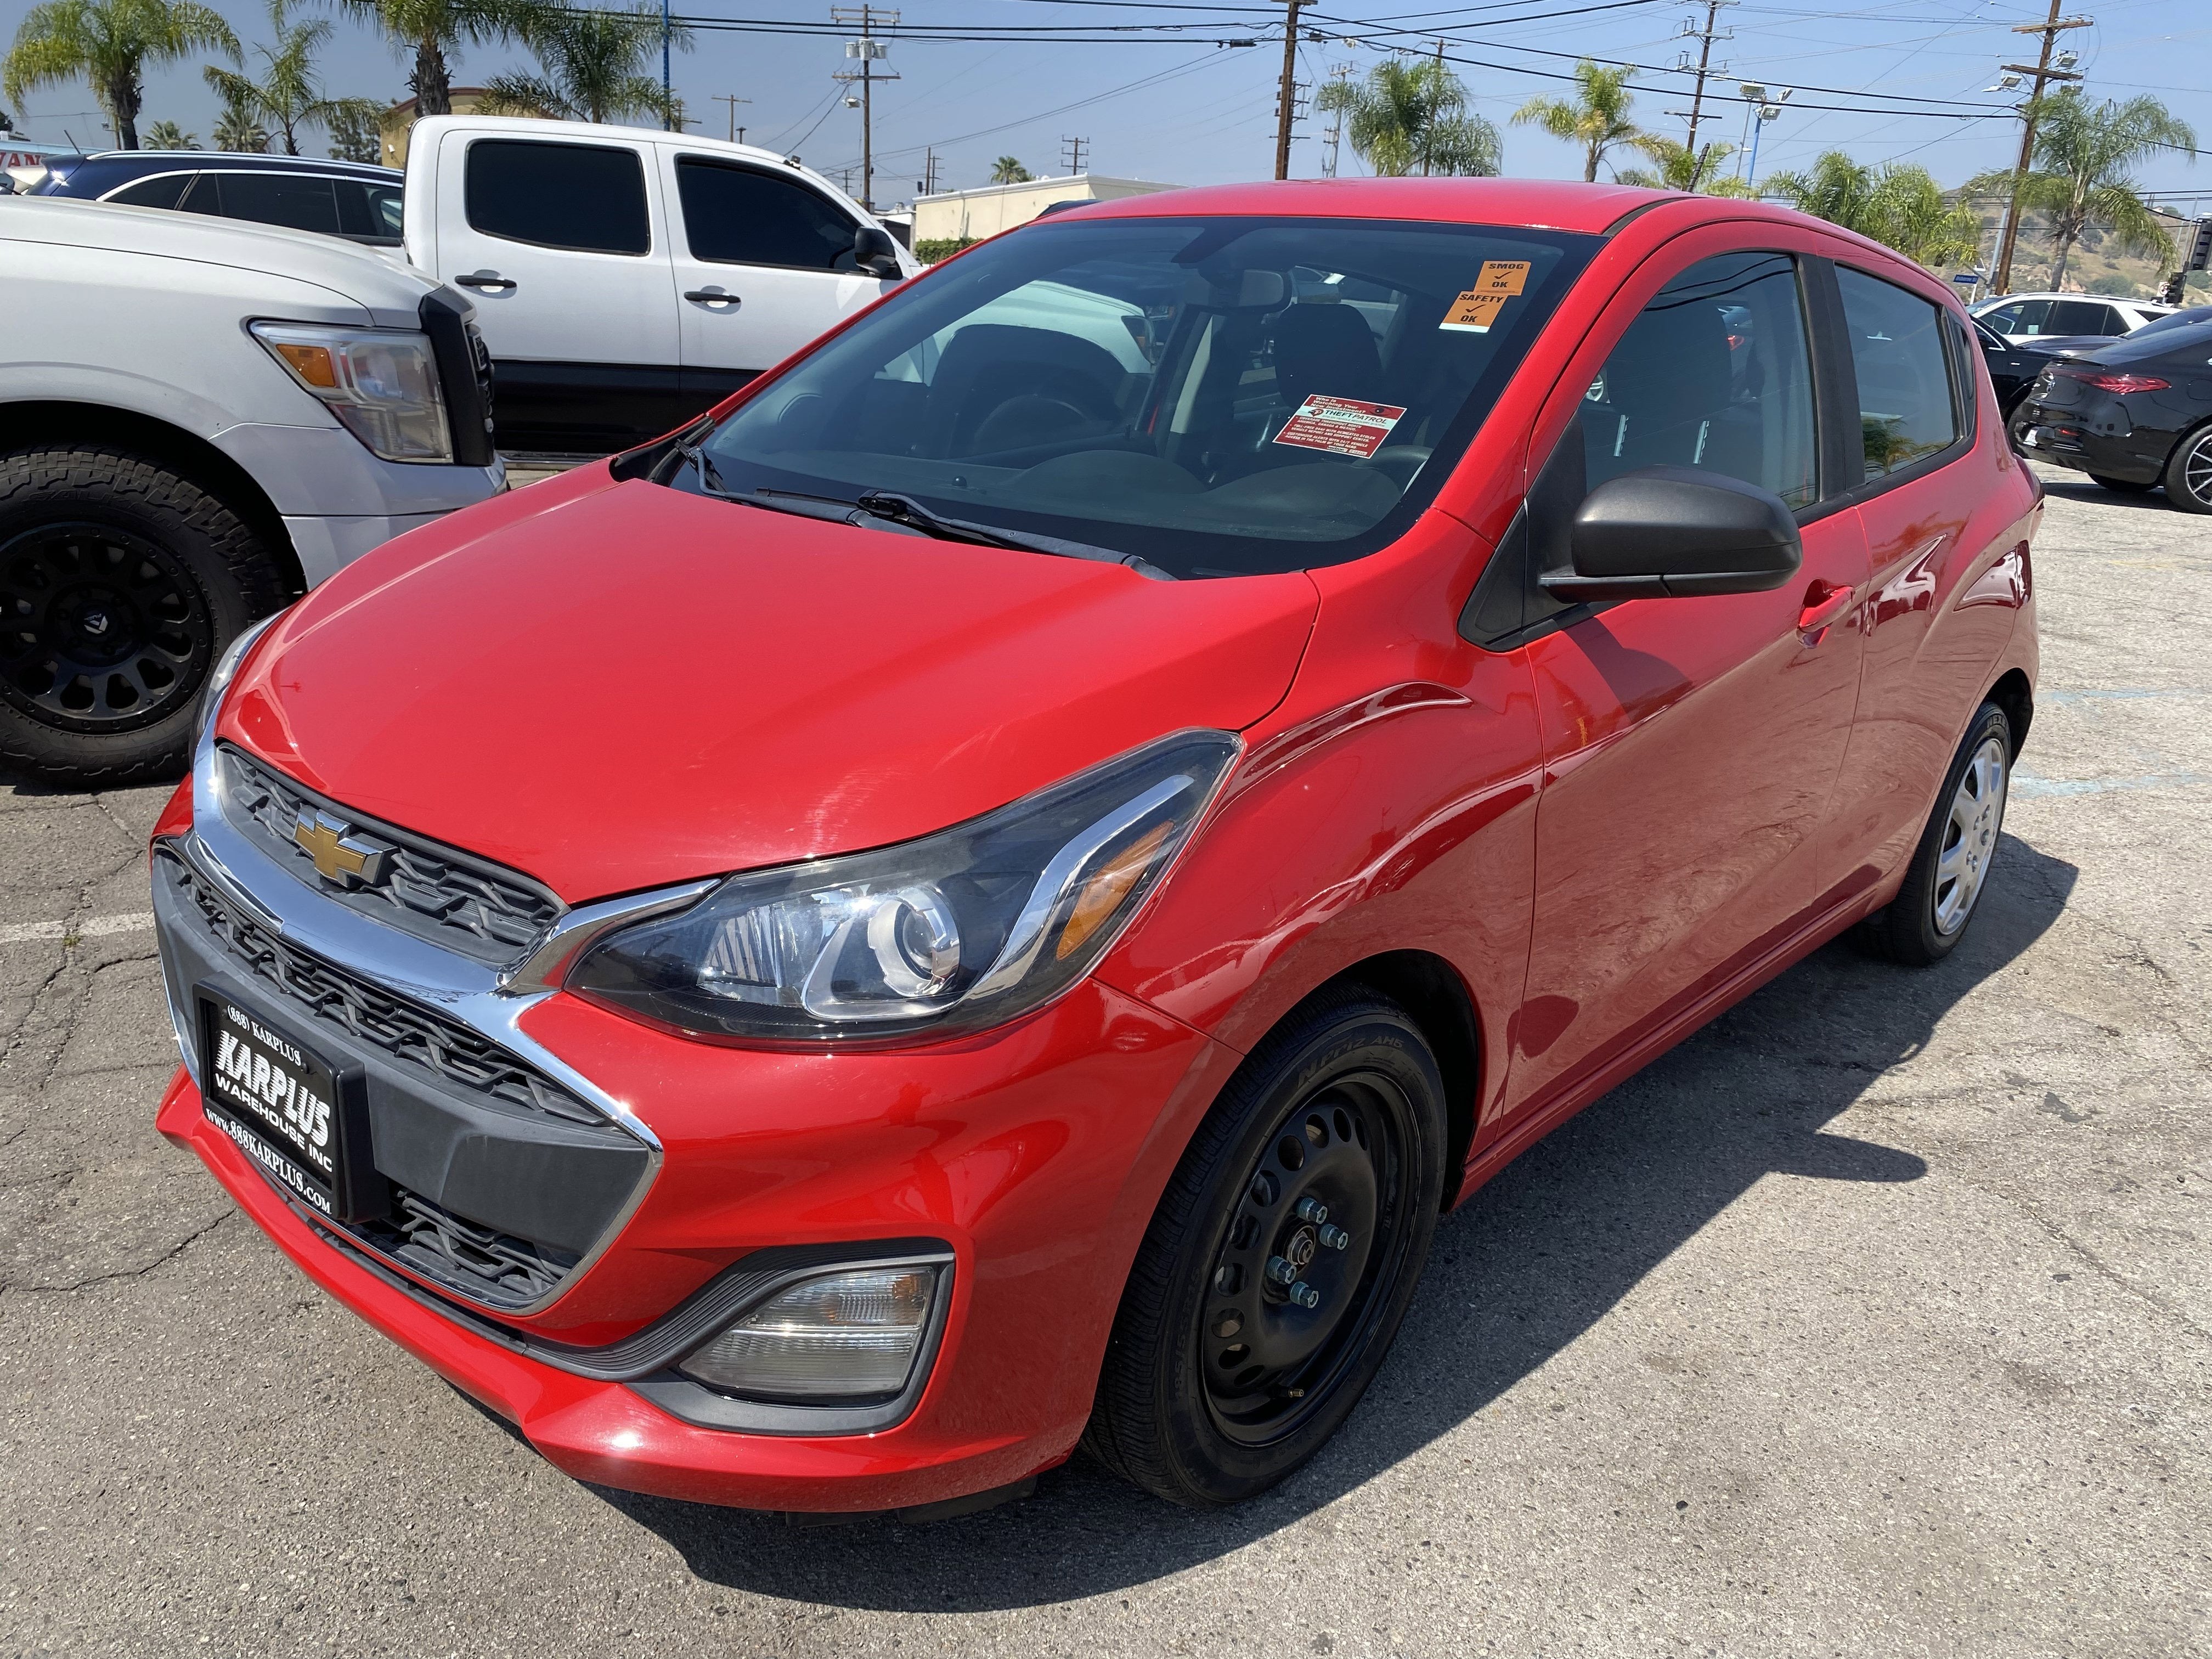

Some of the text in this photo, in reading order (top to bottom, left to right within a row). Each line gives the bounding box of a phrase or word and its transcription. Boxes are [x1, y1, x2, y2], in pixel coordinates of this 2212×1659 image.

[1459, 294, 1504, 303] SAFETY
[1323, 409, 1387, 424] THEFT PATROL
[227, 1005, 301, 1066] (888) KARPLUS
[216, 1030, 330, 1147] KARPLUS
[215, 1073, 333, 1173] WAREHOUSE INC
